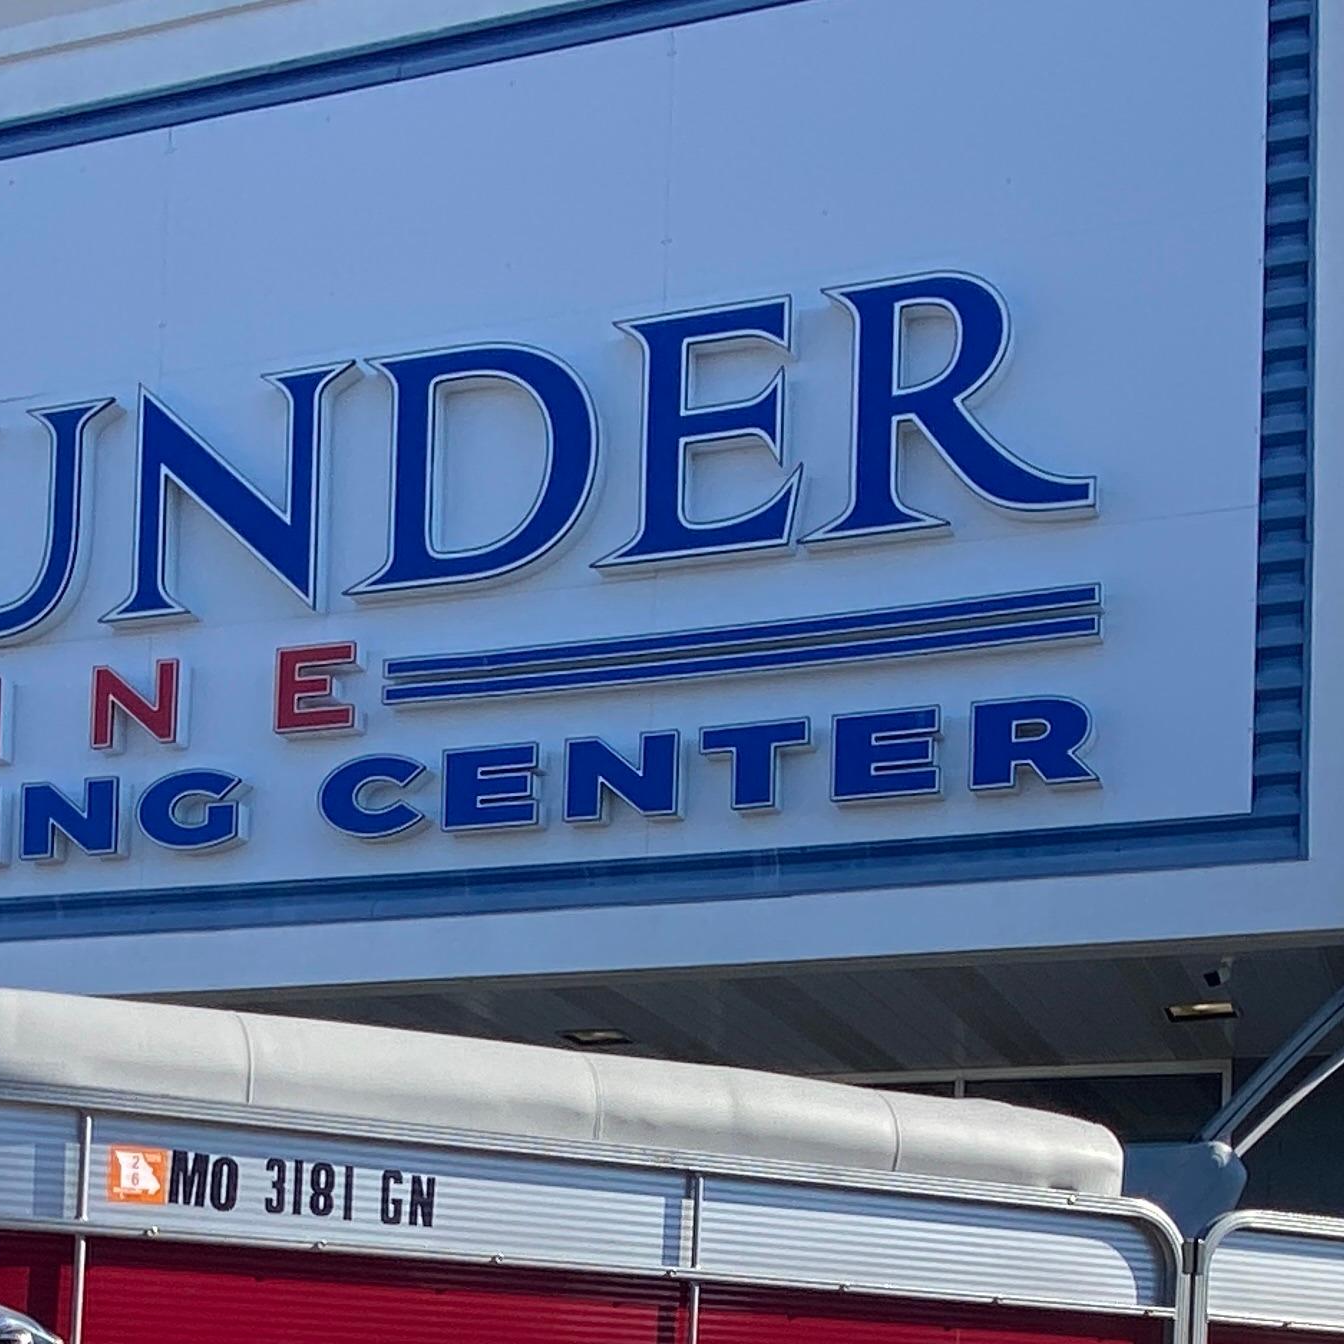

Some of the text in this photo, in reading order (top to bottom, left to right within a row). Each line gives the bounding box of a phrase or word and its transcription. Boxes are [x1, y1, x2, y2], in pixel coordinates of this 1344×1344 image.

[318, 693, 1101, 838] CENTER
[167, 1149, 436, 1228] MO 3181 GN
